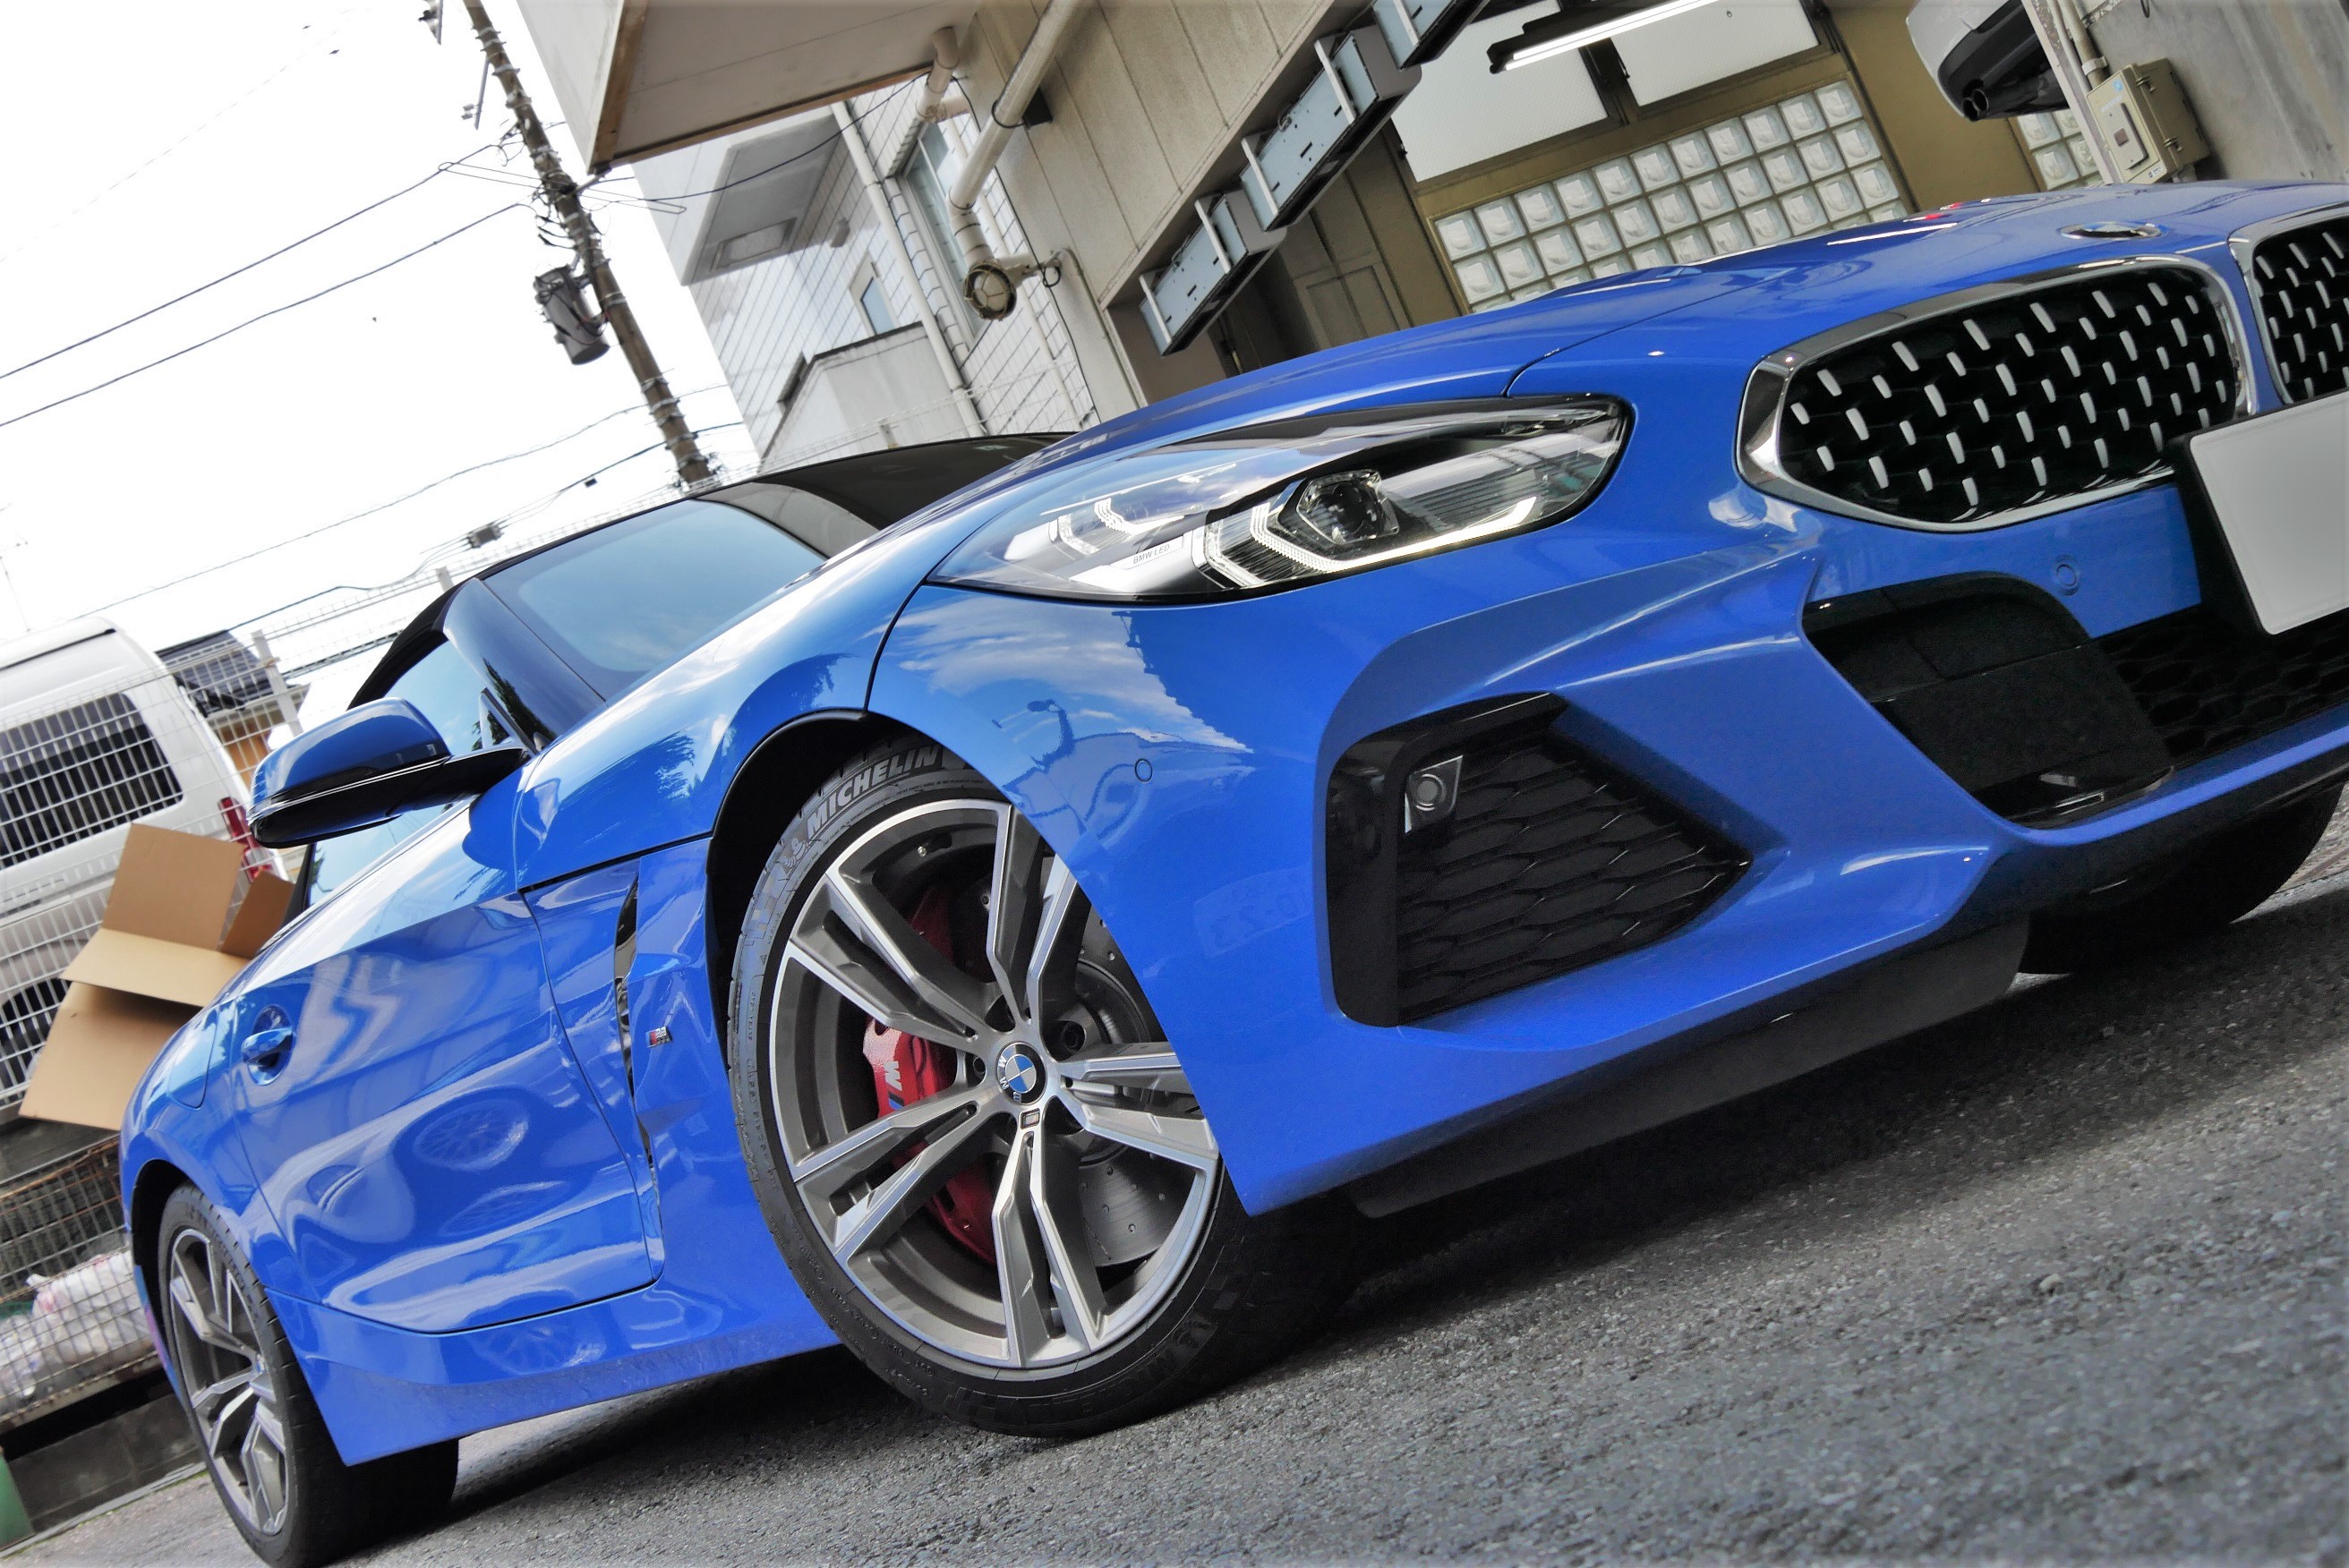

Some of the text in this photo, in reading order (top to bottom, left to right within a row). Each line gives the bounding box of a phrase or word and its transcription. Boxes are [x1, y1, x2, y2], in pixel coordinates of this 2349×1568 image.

[1132, 543, 1170, 564] BMW LED
[807, 746, 939, 839] MICHELIN
